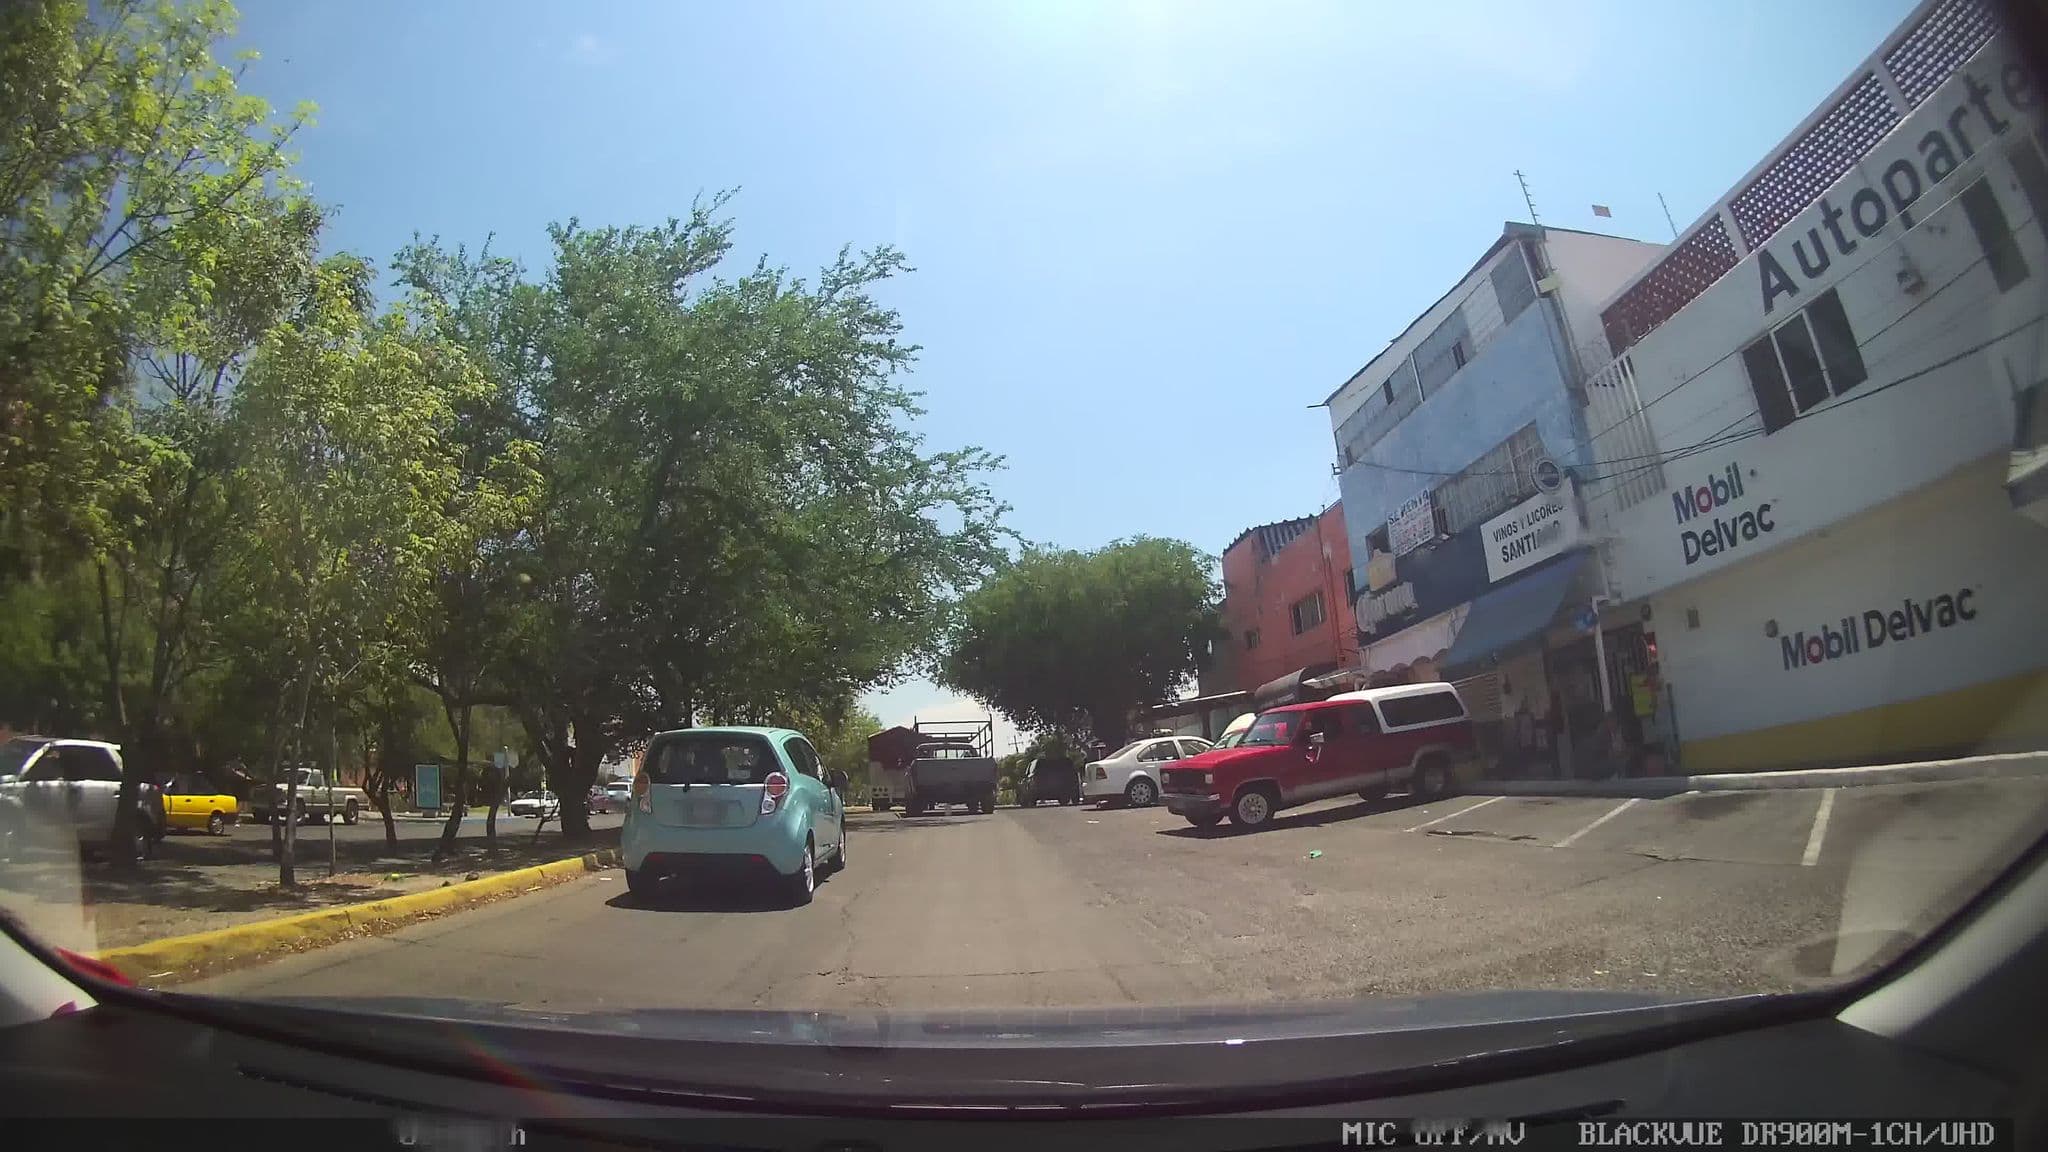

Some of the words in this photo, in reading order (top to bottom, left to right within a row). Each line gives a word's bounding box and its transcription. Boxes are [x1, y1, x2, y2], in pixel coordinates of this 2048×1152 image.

[1672, 461, 1744, 524] Mobil
[1493, 521, 1518, 543] VINOS
[1501, 520, 1561, 563] SANTI
[1681, 503, 1775, 565] Delvac
[1781, 616, 1860, 671] Mobil
[1863, 587, 1977, 649] Delvac
